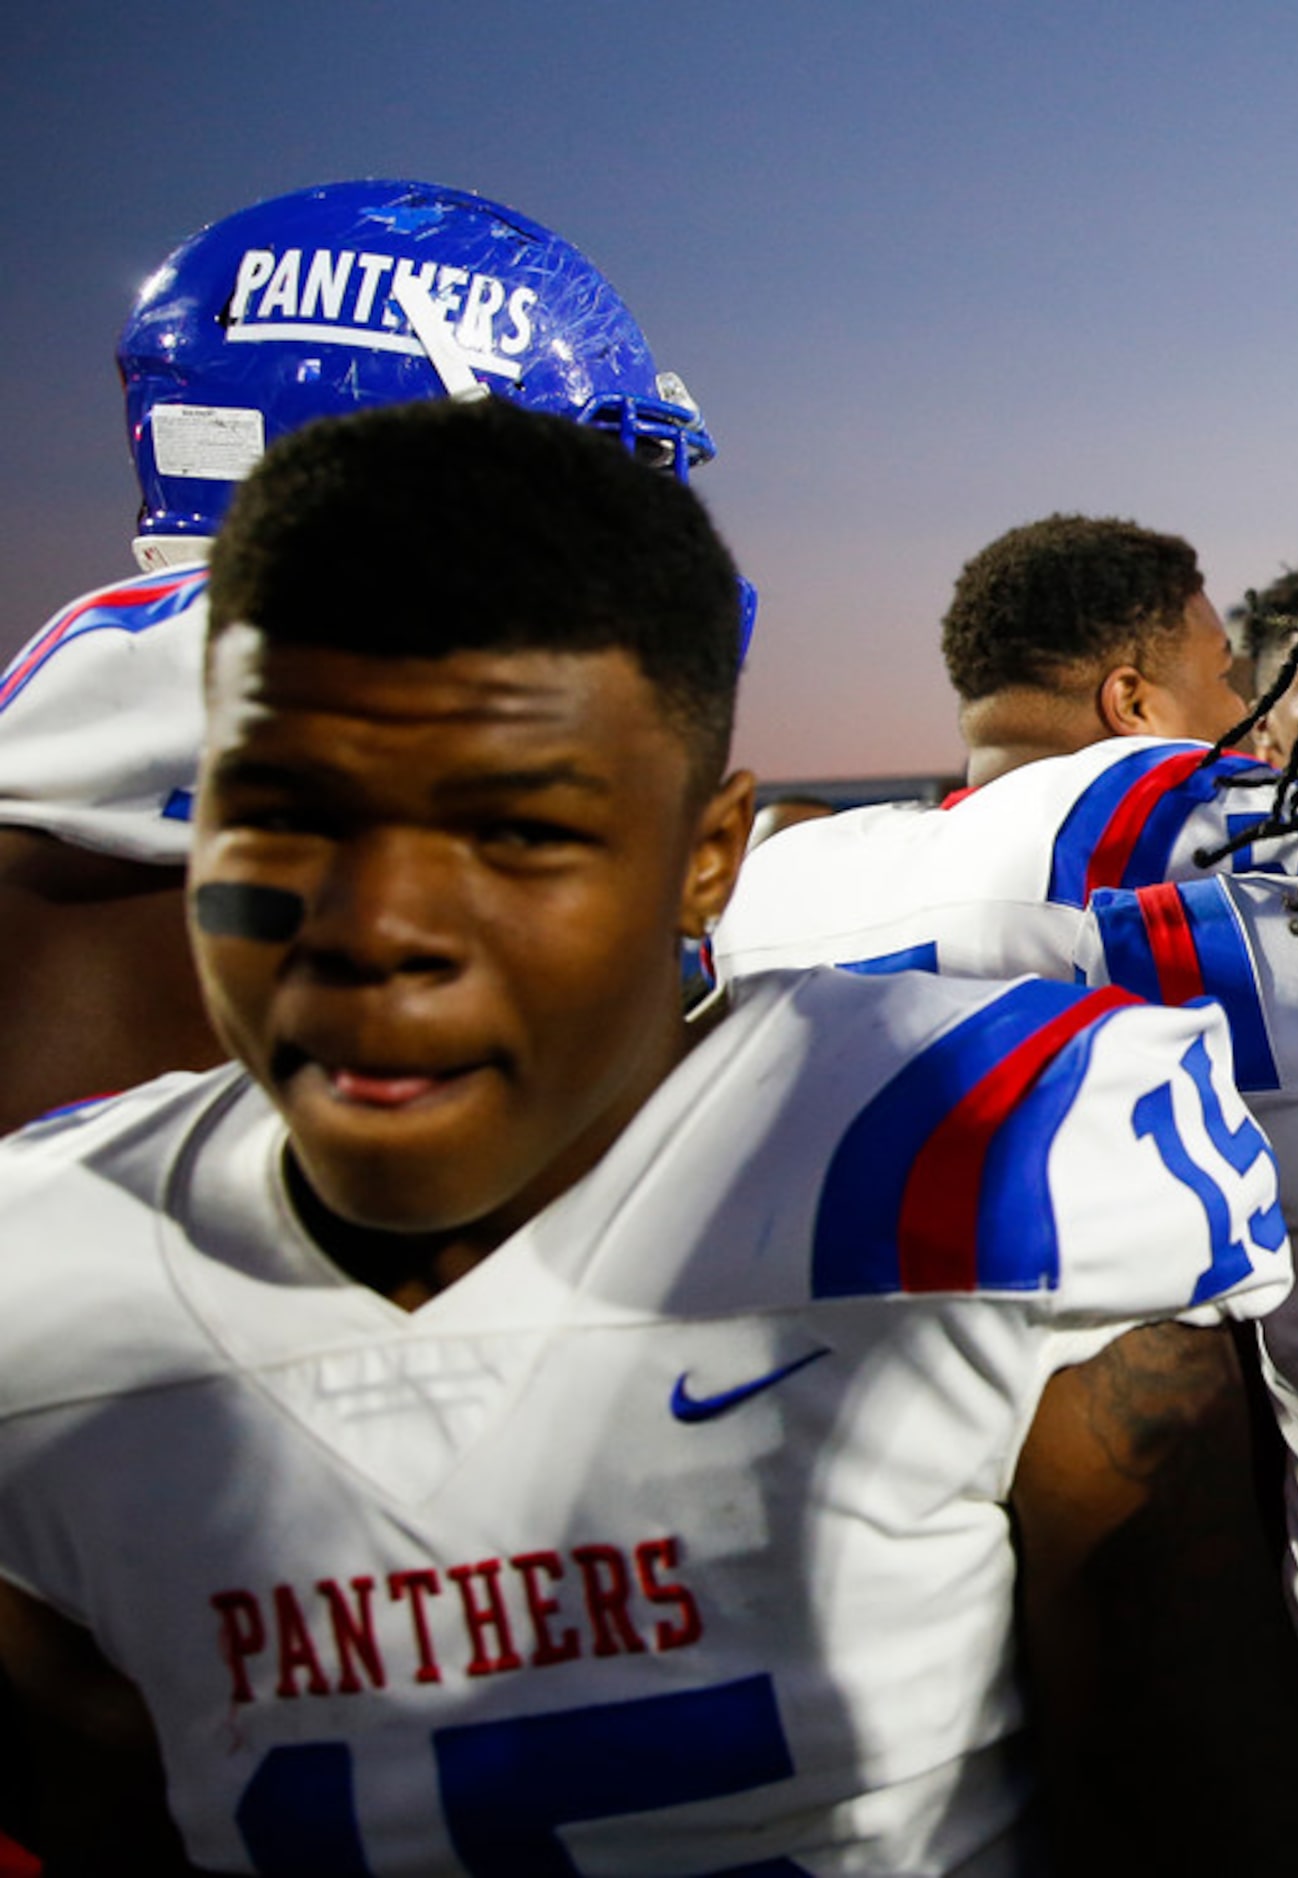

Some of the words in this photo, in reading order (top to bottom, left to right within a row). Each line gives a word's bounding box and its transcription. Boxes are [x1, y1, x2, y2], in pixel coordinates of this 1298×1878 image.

[229, 249, 538, 356] PANTHERS
[1130, 1031, 1288, 1307] 15
[210, 1536, 703, 1703] PANTHERS
